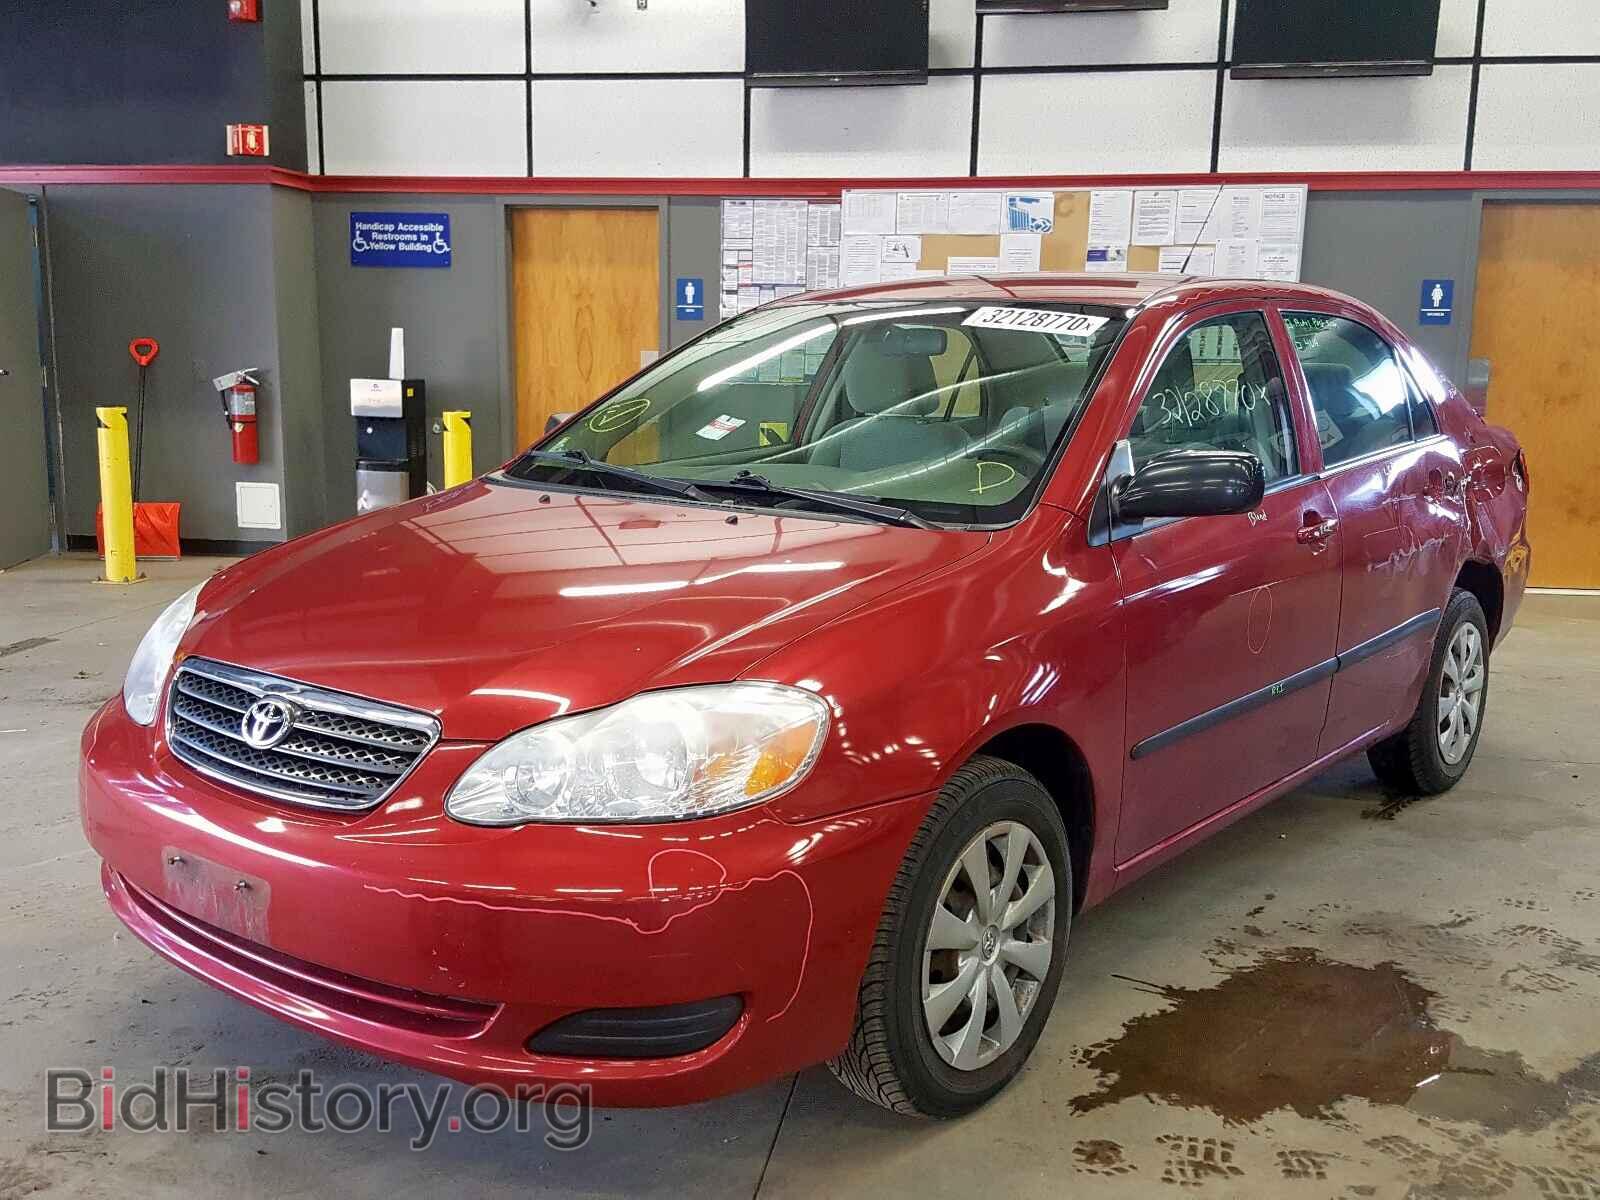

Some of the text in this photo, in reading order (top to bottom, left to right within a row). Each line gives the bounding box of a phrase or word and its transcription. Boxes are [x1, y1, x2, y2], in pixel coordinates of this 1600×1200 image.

[355, 222, 444, 232] Handicap Accessible
[371, 232, 418, 241] Restrooms
[369, 241, 432, 252] Yellow Building
